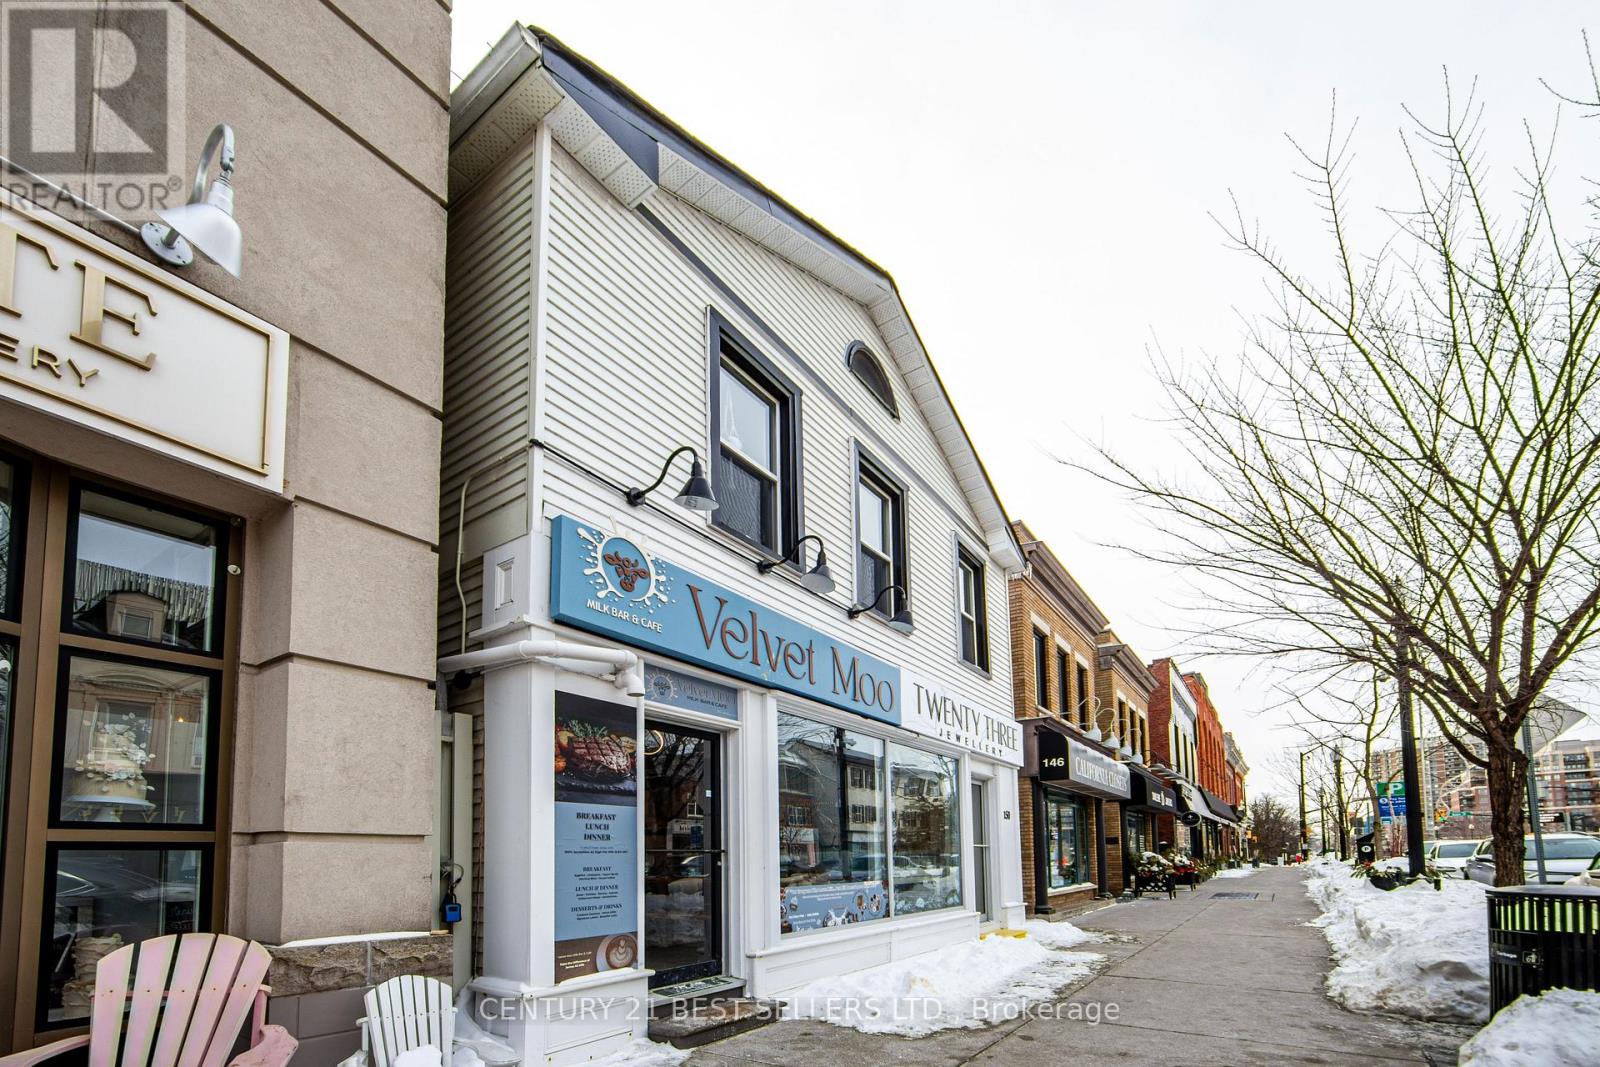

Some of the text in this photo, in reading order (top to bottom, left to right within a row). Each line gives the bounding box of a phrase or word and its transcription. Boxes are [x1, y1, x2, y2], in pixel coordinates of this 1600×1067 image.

[587, 598, 663, 633] MILK BAR & CAFE
[686, 583, 816, 685] Velvet
[913, 682, 1018, 752] TWENTY THREE
[939, 728, 1003, 757] JEWELLERY
[1042, 757, 1065, 768] 146
[1075, 756, 1127, 792] CALIFORNIA CLOSETS
[1391, 783, 1402, 794] P
[576, 812, 616, 821] BREAKFAST
[584, 833, 611, 841] DINNER
[585, 823, 609, 831] LUNCH
